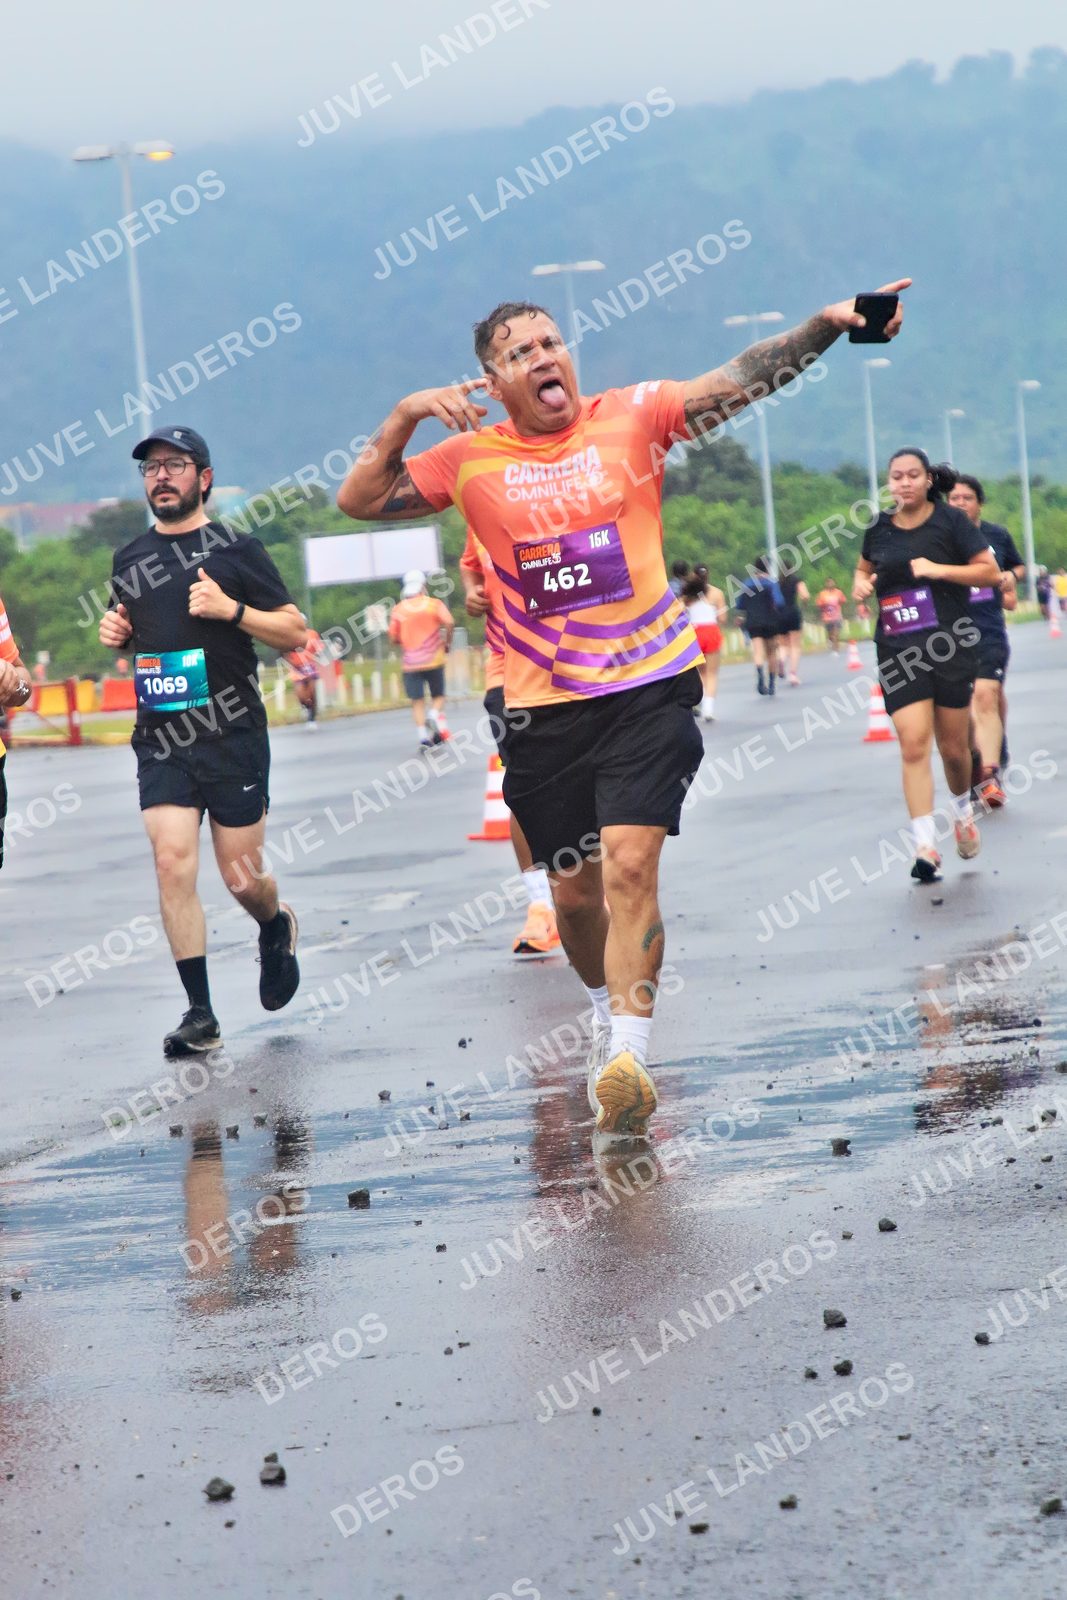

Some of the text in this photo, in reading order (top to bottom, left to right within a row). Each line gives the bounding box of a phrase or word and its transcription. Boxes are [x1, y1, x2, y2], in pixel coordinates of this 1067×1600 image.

[503, 444, 601, 485] CARRERA
[519, 543, 561, 561] CARRERA
[543, 563, 592, 592] 462
[893, 606, 919, 622] 135
[182, 653, 198, 668] 10K
[144, 675, 188, 695] 1069
